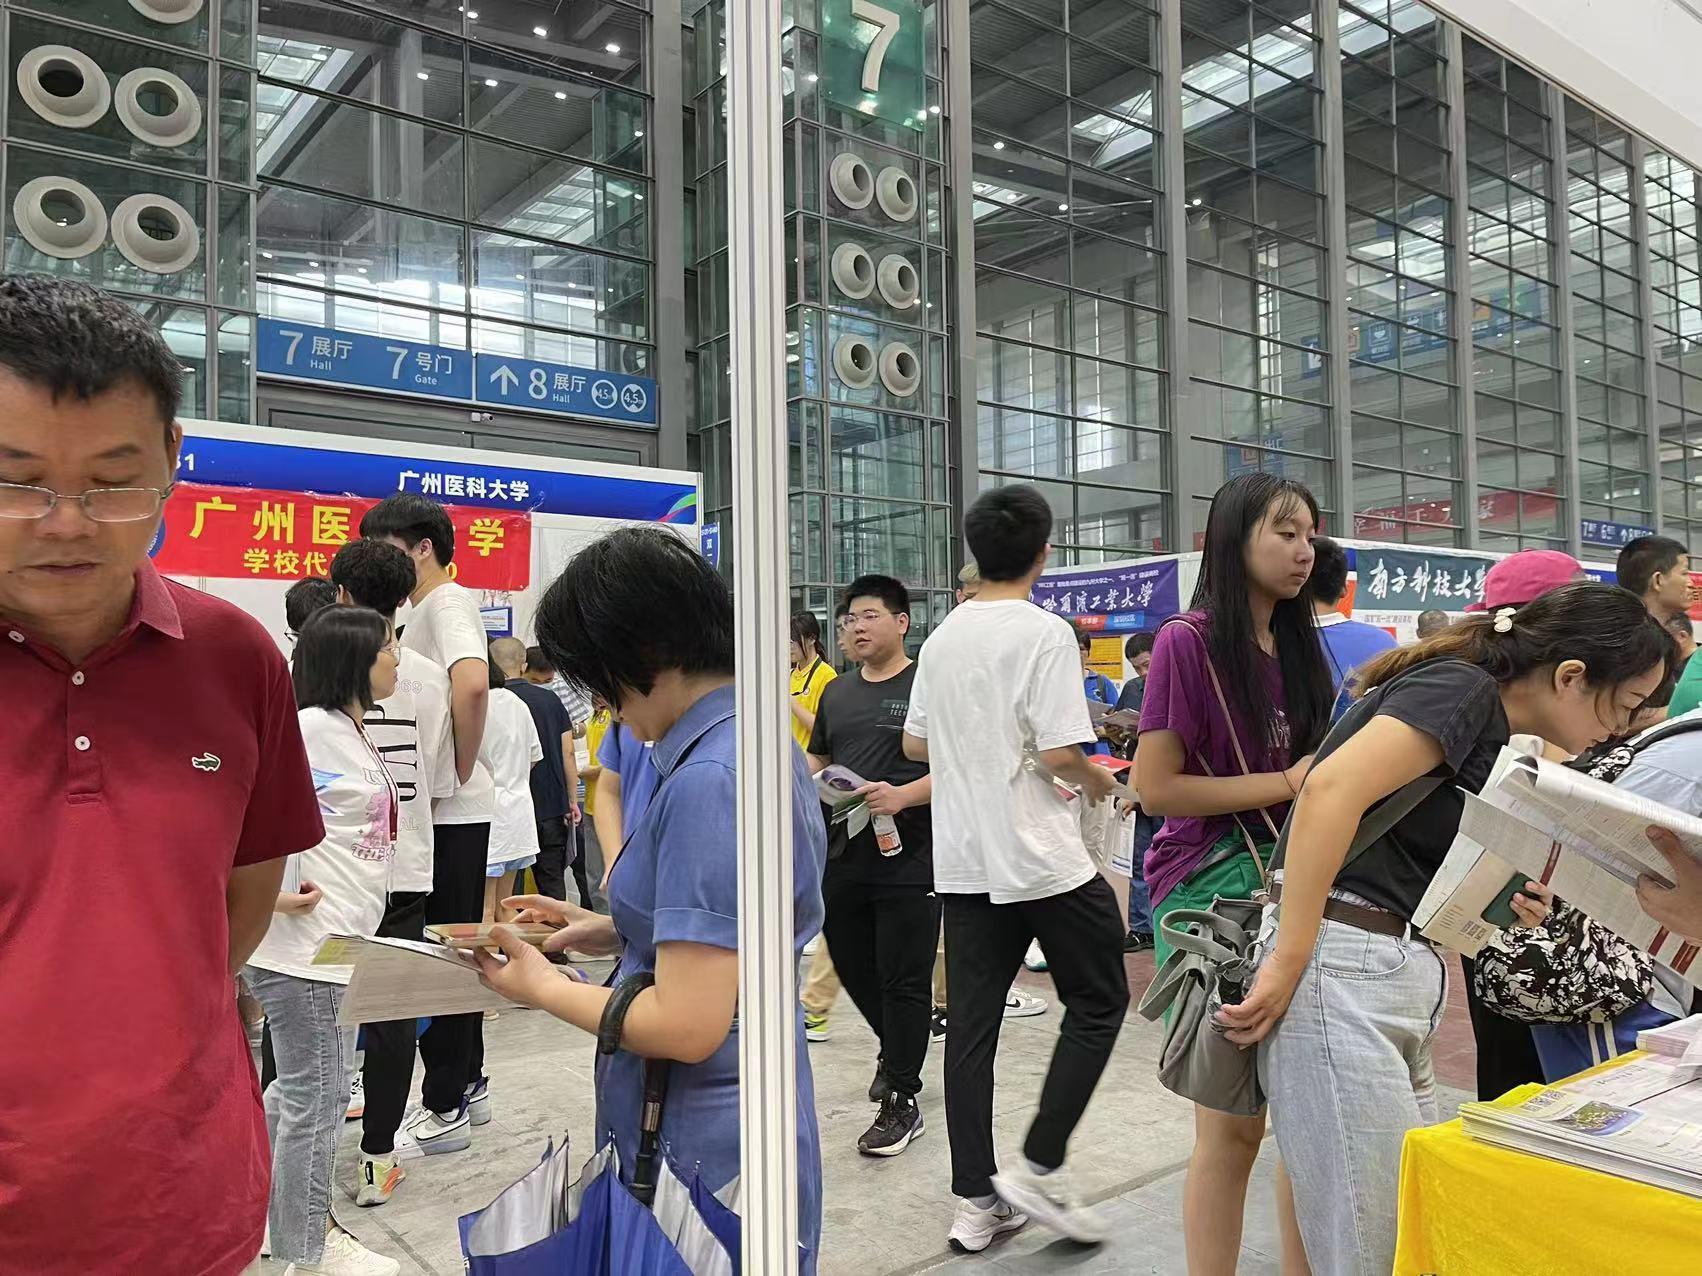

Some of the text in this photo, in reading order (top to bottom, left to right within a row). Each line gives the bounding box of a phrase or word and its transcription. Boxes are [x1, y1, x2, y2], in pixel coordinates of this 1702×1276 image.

[851, 0, 900, 93] 7
[279, 329, 452, 380] 7 展厅 7 号门
[310, 359, 438, 386] Hall Gate
[528, 368, 548, 400] 8
[553, 372, 587, 393] 展厅
[553, 393, 570, 404] Hall
[397, 470, 530, 502] 广州医科大学
[189, 496, 505, 557] 广州医学
